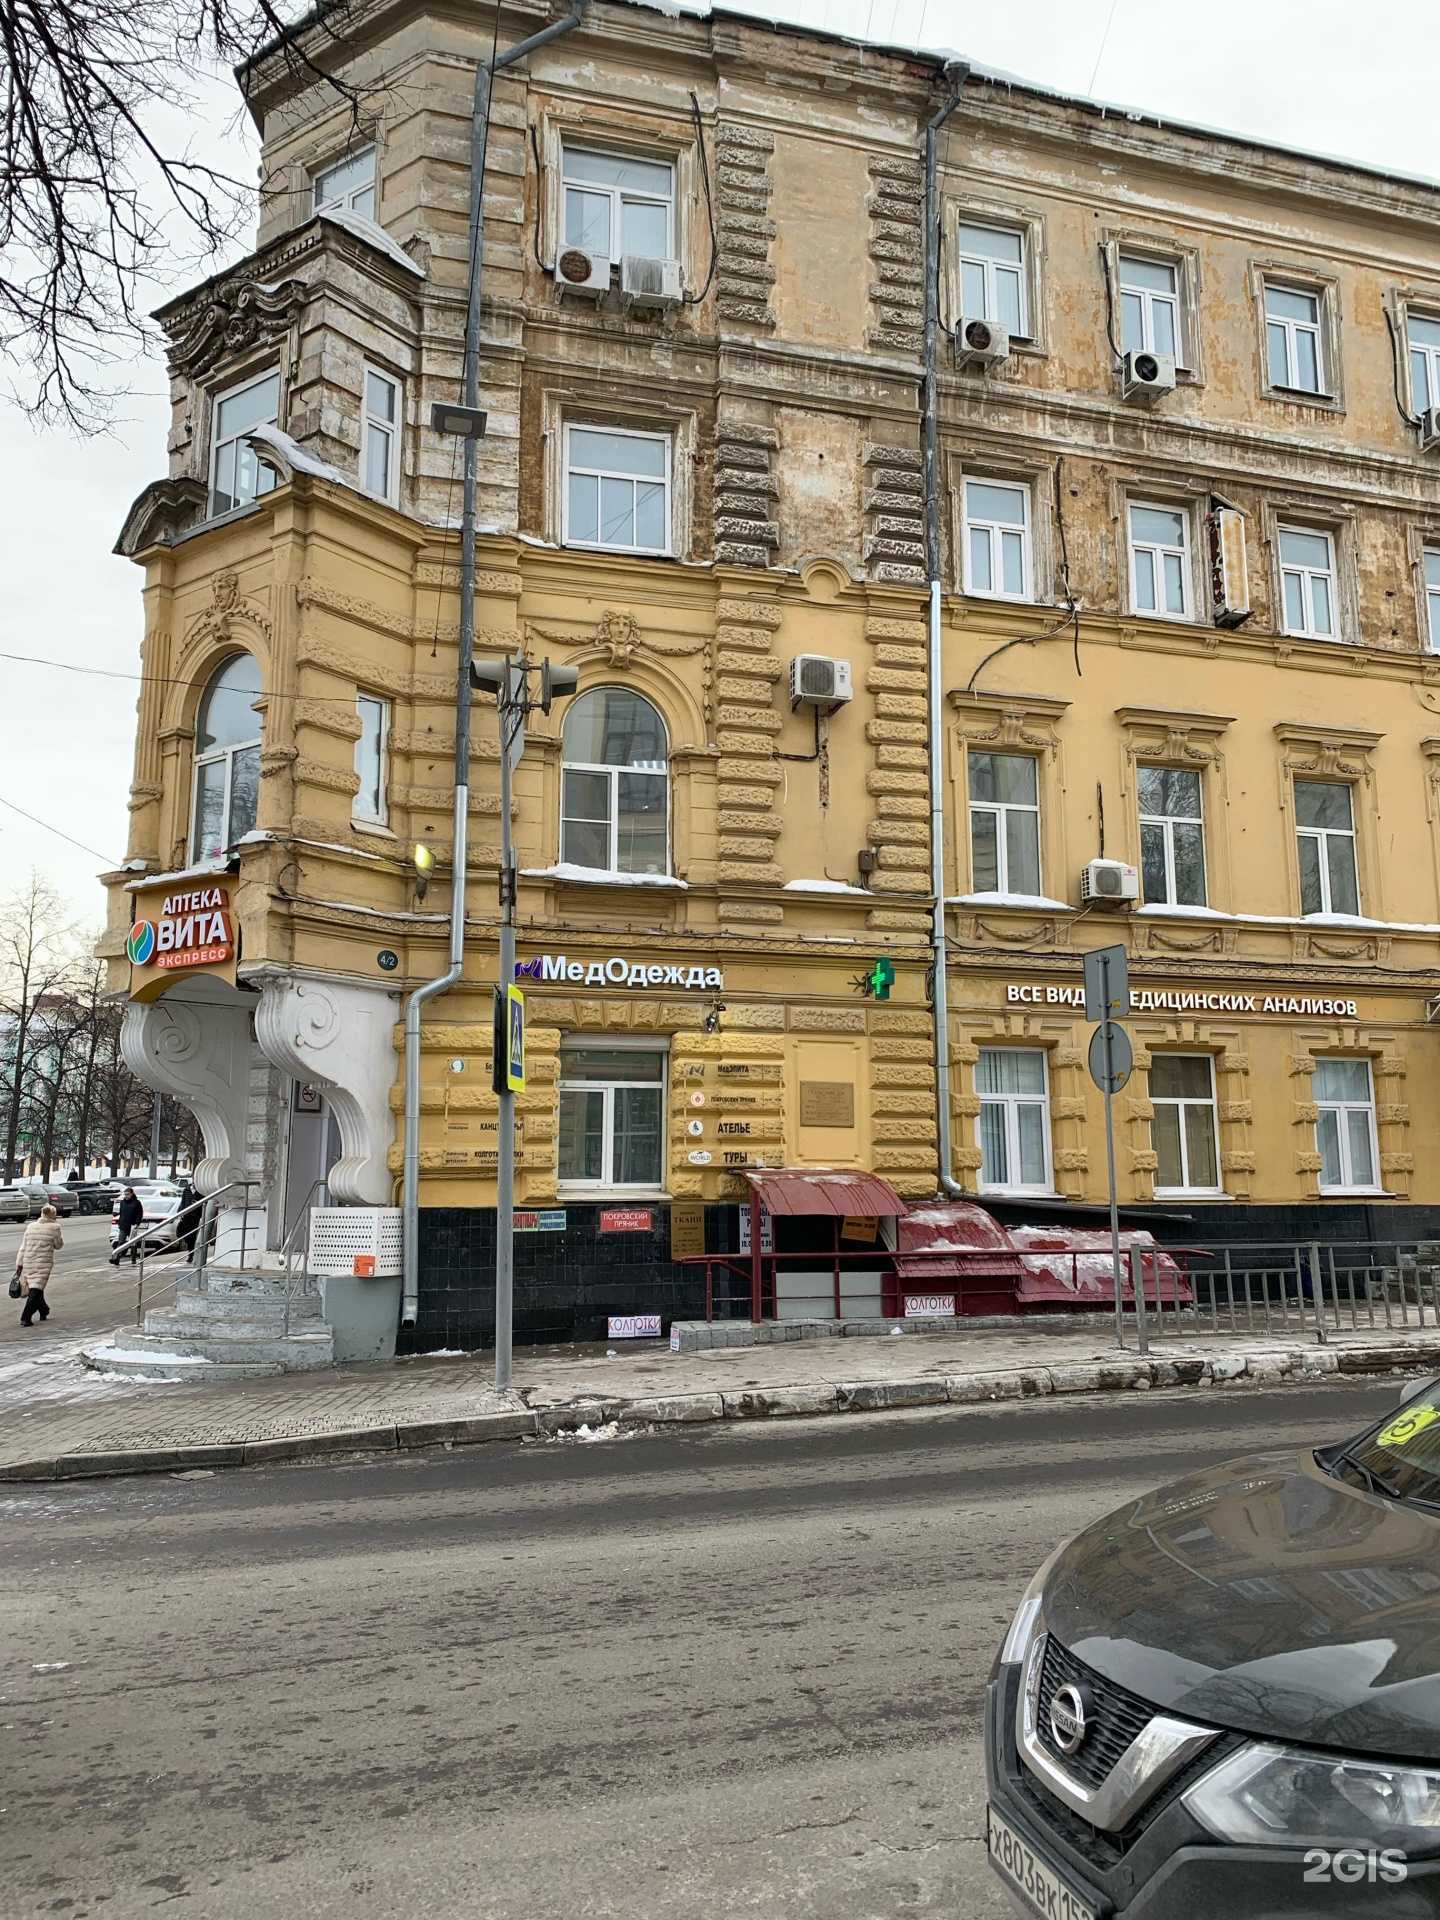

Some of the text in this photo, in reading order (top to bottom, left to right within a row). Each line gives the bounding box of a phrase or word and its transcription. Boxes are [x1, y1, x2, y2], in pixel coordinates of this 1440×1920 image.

[161, 887, 223, 916] АПТЕКА
[156, 910, 228, 952] ВИТА
[157, 948, 227, 968] ЭКСПРЕСС
[542, 955, 721, 989] МедОдежда
[1007, 985, 1358, 1016] ВСЕ ВИД ЕДИЦИНСКИХ АНАЛИЗОВ
[717, 1122, 751, 1134] АТЕЛЬЕ
[724, 1152, 748, 1163] ТУРЫ
[603, 1211, 648, 1221] ПОКРОВСКИЙ
[614, 1220, 640, 1228] ПРЯНИК
[905, 1297, 954, 1310] КОЛГОТКИ
[608, 1317, 661, 1331] КОЛГОТКИ
